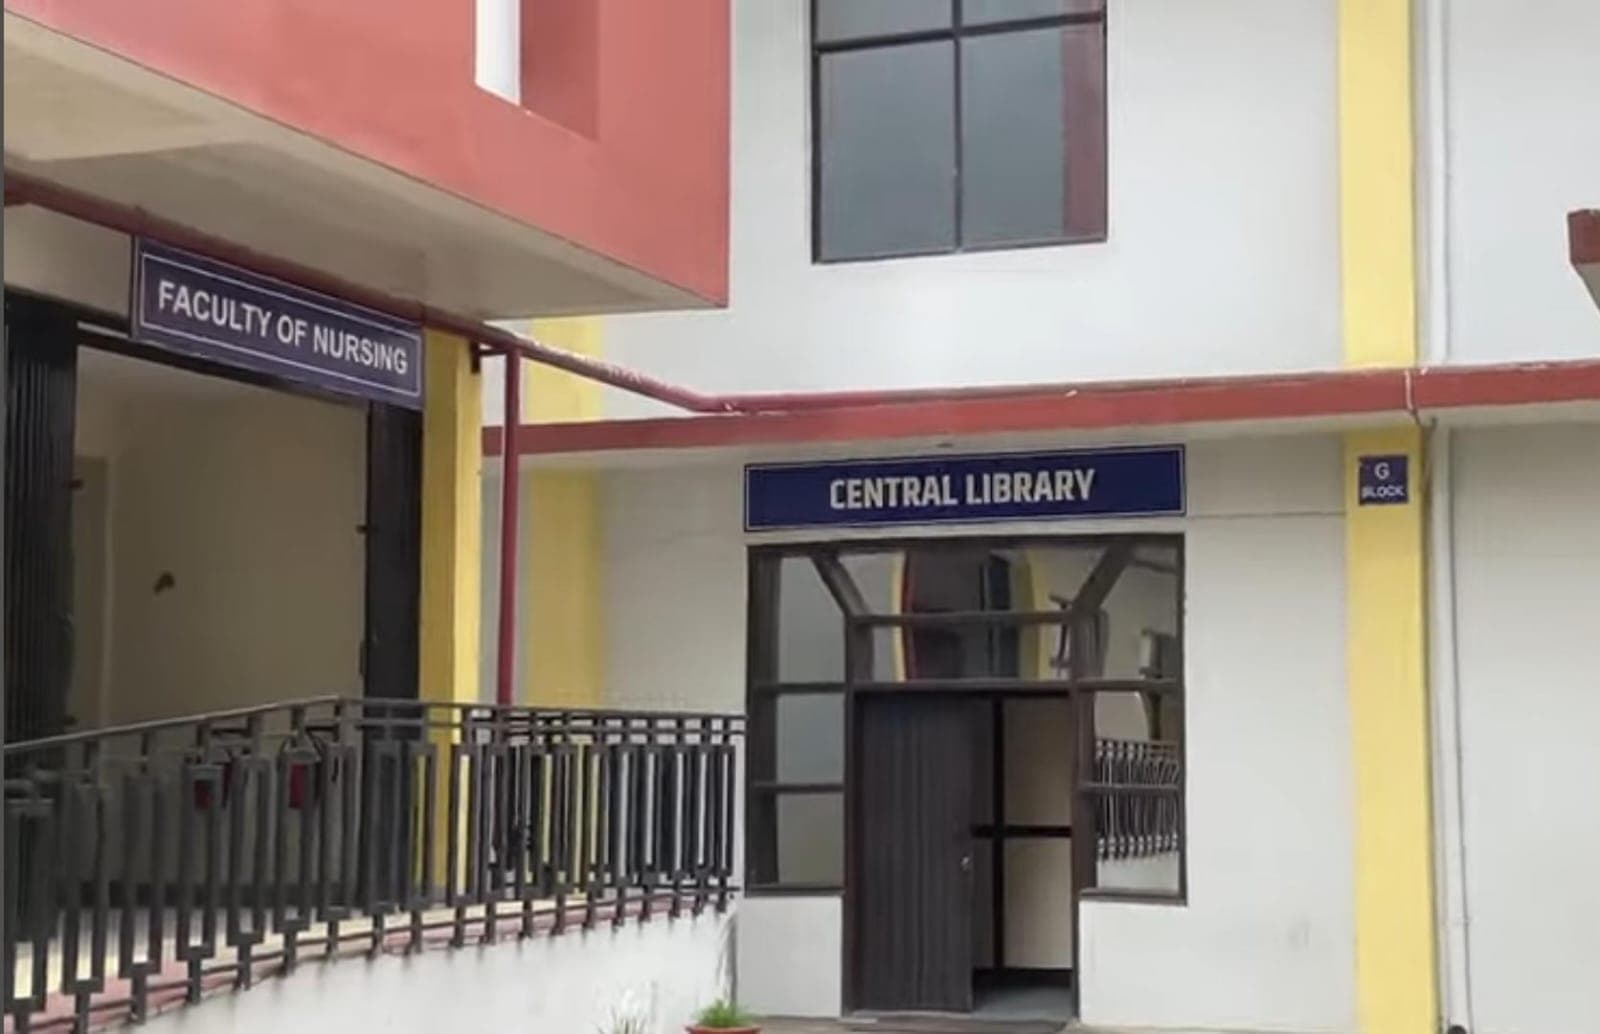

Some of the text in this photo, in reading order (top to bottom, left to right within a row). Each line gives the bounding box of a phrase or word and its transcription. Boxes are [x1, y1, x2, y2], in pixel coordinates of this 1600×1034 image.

[158, 279, 409, 376] FACULTY OF NURSING
[830, 467, 1095, 510] CENTRAL LIBRARY
[1374, 462, 1390, 480] G
